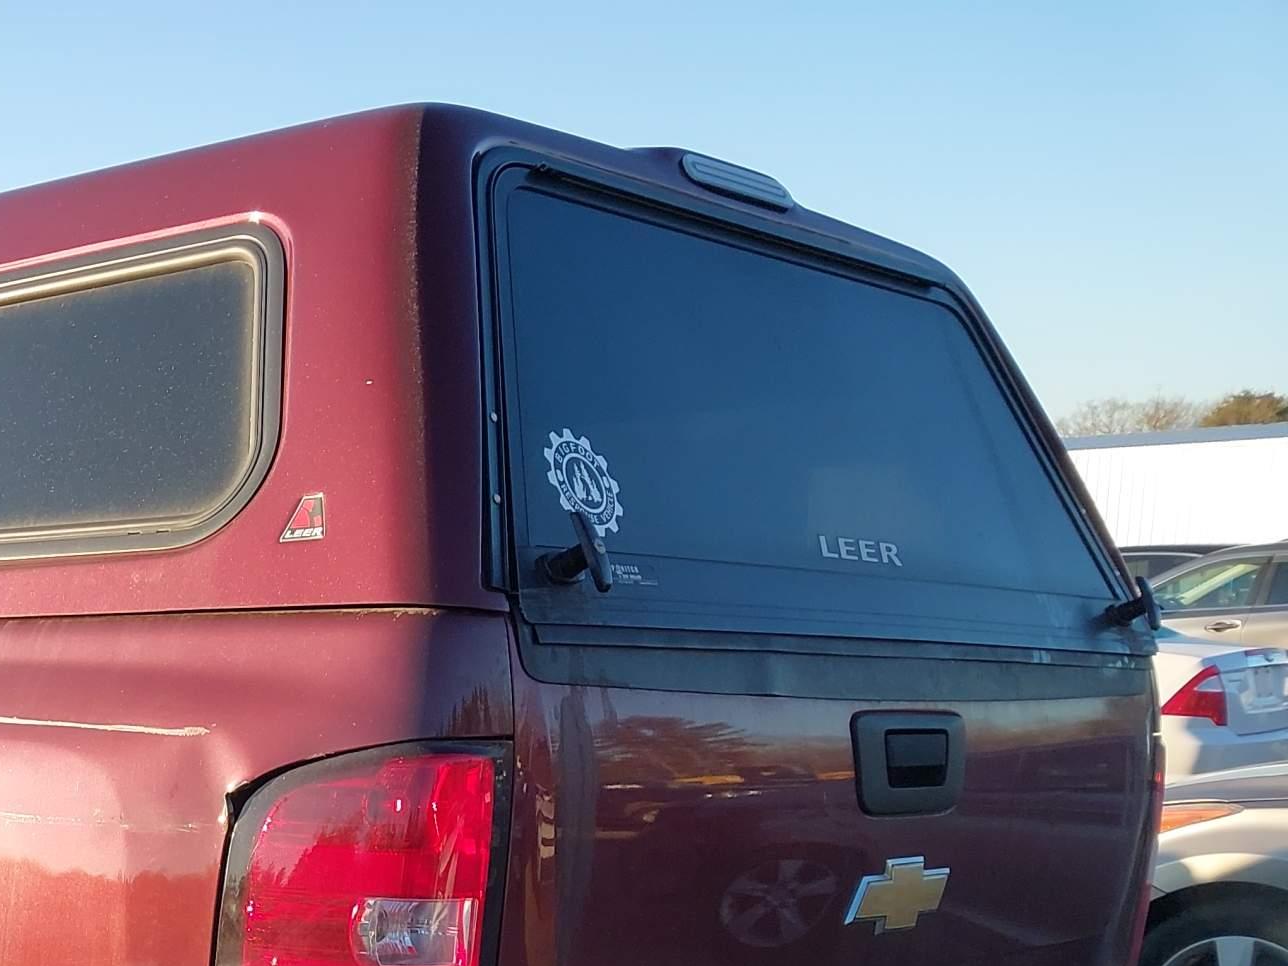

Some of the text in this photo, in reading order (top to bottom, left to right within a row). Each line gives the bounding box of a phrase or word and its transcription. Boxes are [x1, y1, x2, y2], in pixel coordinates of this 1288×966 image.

[555, 442, 600, 468] BIGFOOT
[284, 526, 323, 539] LEER
[818, 535, 903, 567] LEER
